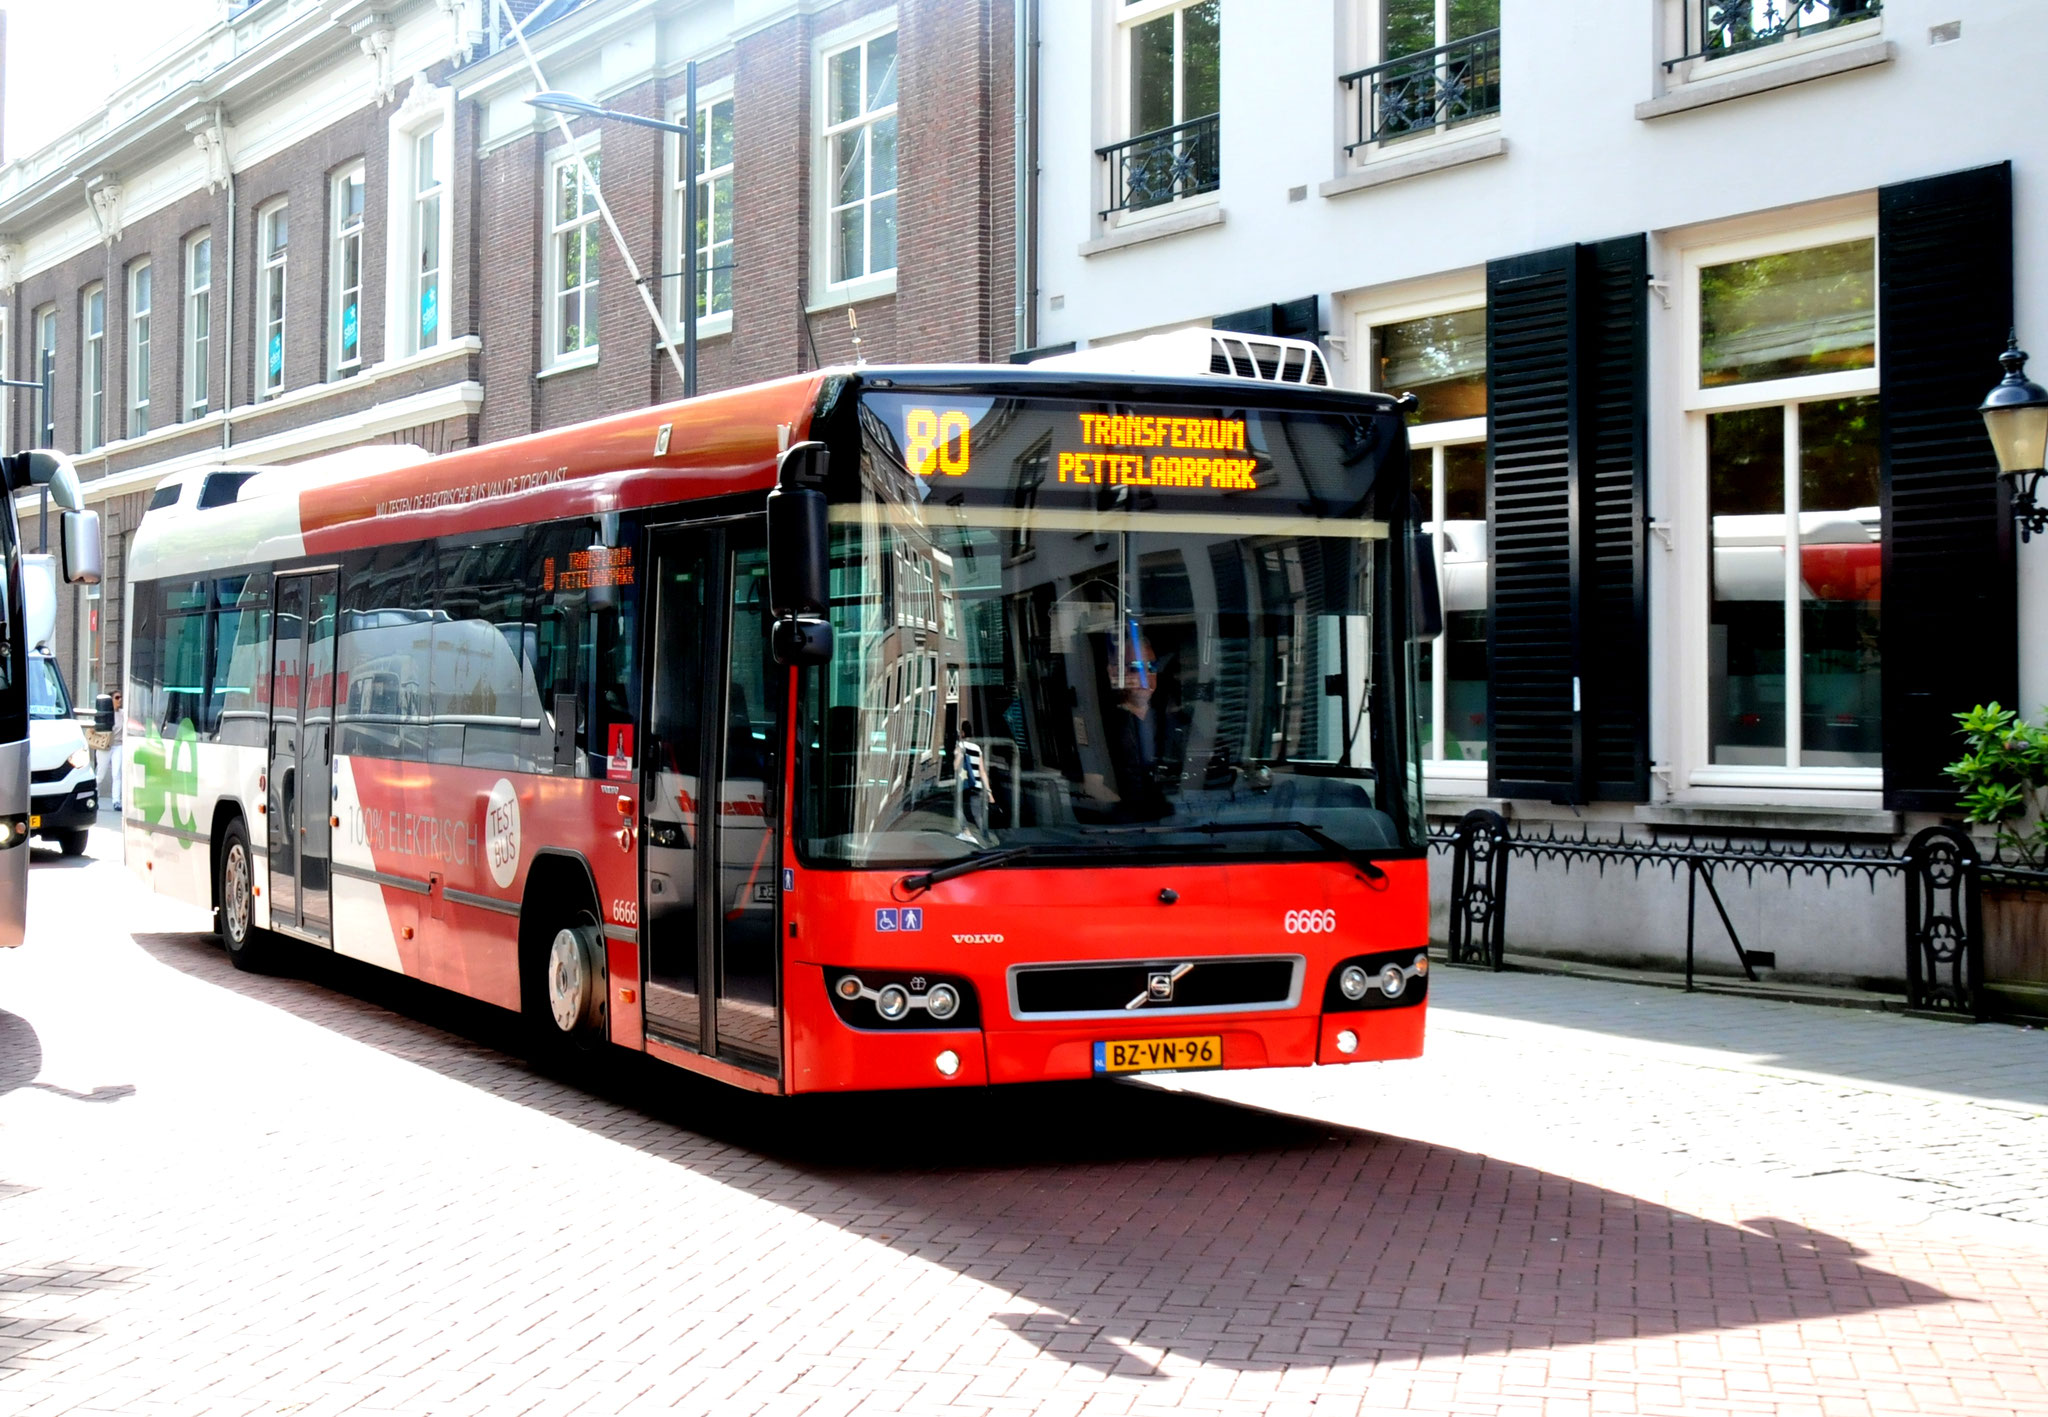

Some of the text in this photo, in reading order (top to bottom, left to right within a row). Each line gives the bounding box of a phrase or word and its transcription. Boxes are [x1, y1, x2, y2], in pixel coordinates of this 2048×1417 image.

[906, 408, 970, 477] 80
[1079, 413, 1245, 451] TRANSFERIUM
[1058, 452, 1257, 490] PETTELAARPARK
[388, 497, 412, 515] TESTEN
[412, 494, 424, 511] DE
[424, 486, 469, 510] ELEKTRISCHE
[470, 482, 487, 502] BUS
[487, 479, 505, 499] VAN
[505, 476, 519, 495] DE
[519, 466, 568, 492] TOEKOMST
[350, 805, 479, 867] 100% ELEKTRISCH
[490, 799, 515, 837] TEST
[495, 832, 516, 869] BUS
[613, 899, 637, 924] 6666
[1284, 909, 1336, 934] 6666
[952, 934, 1005, 944] VOLVO
[1113, 1041, 1213, 1067] BZ-VN-96
